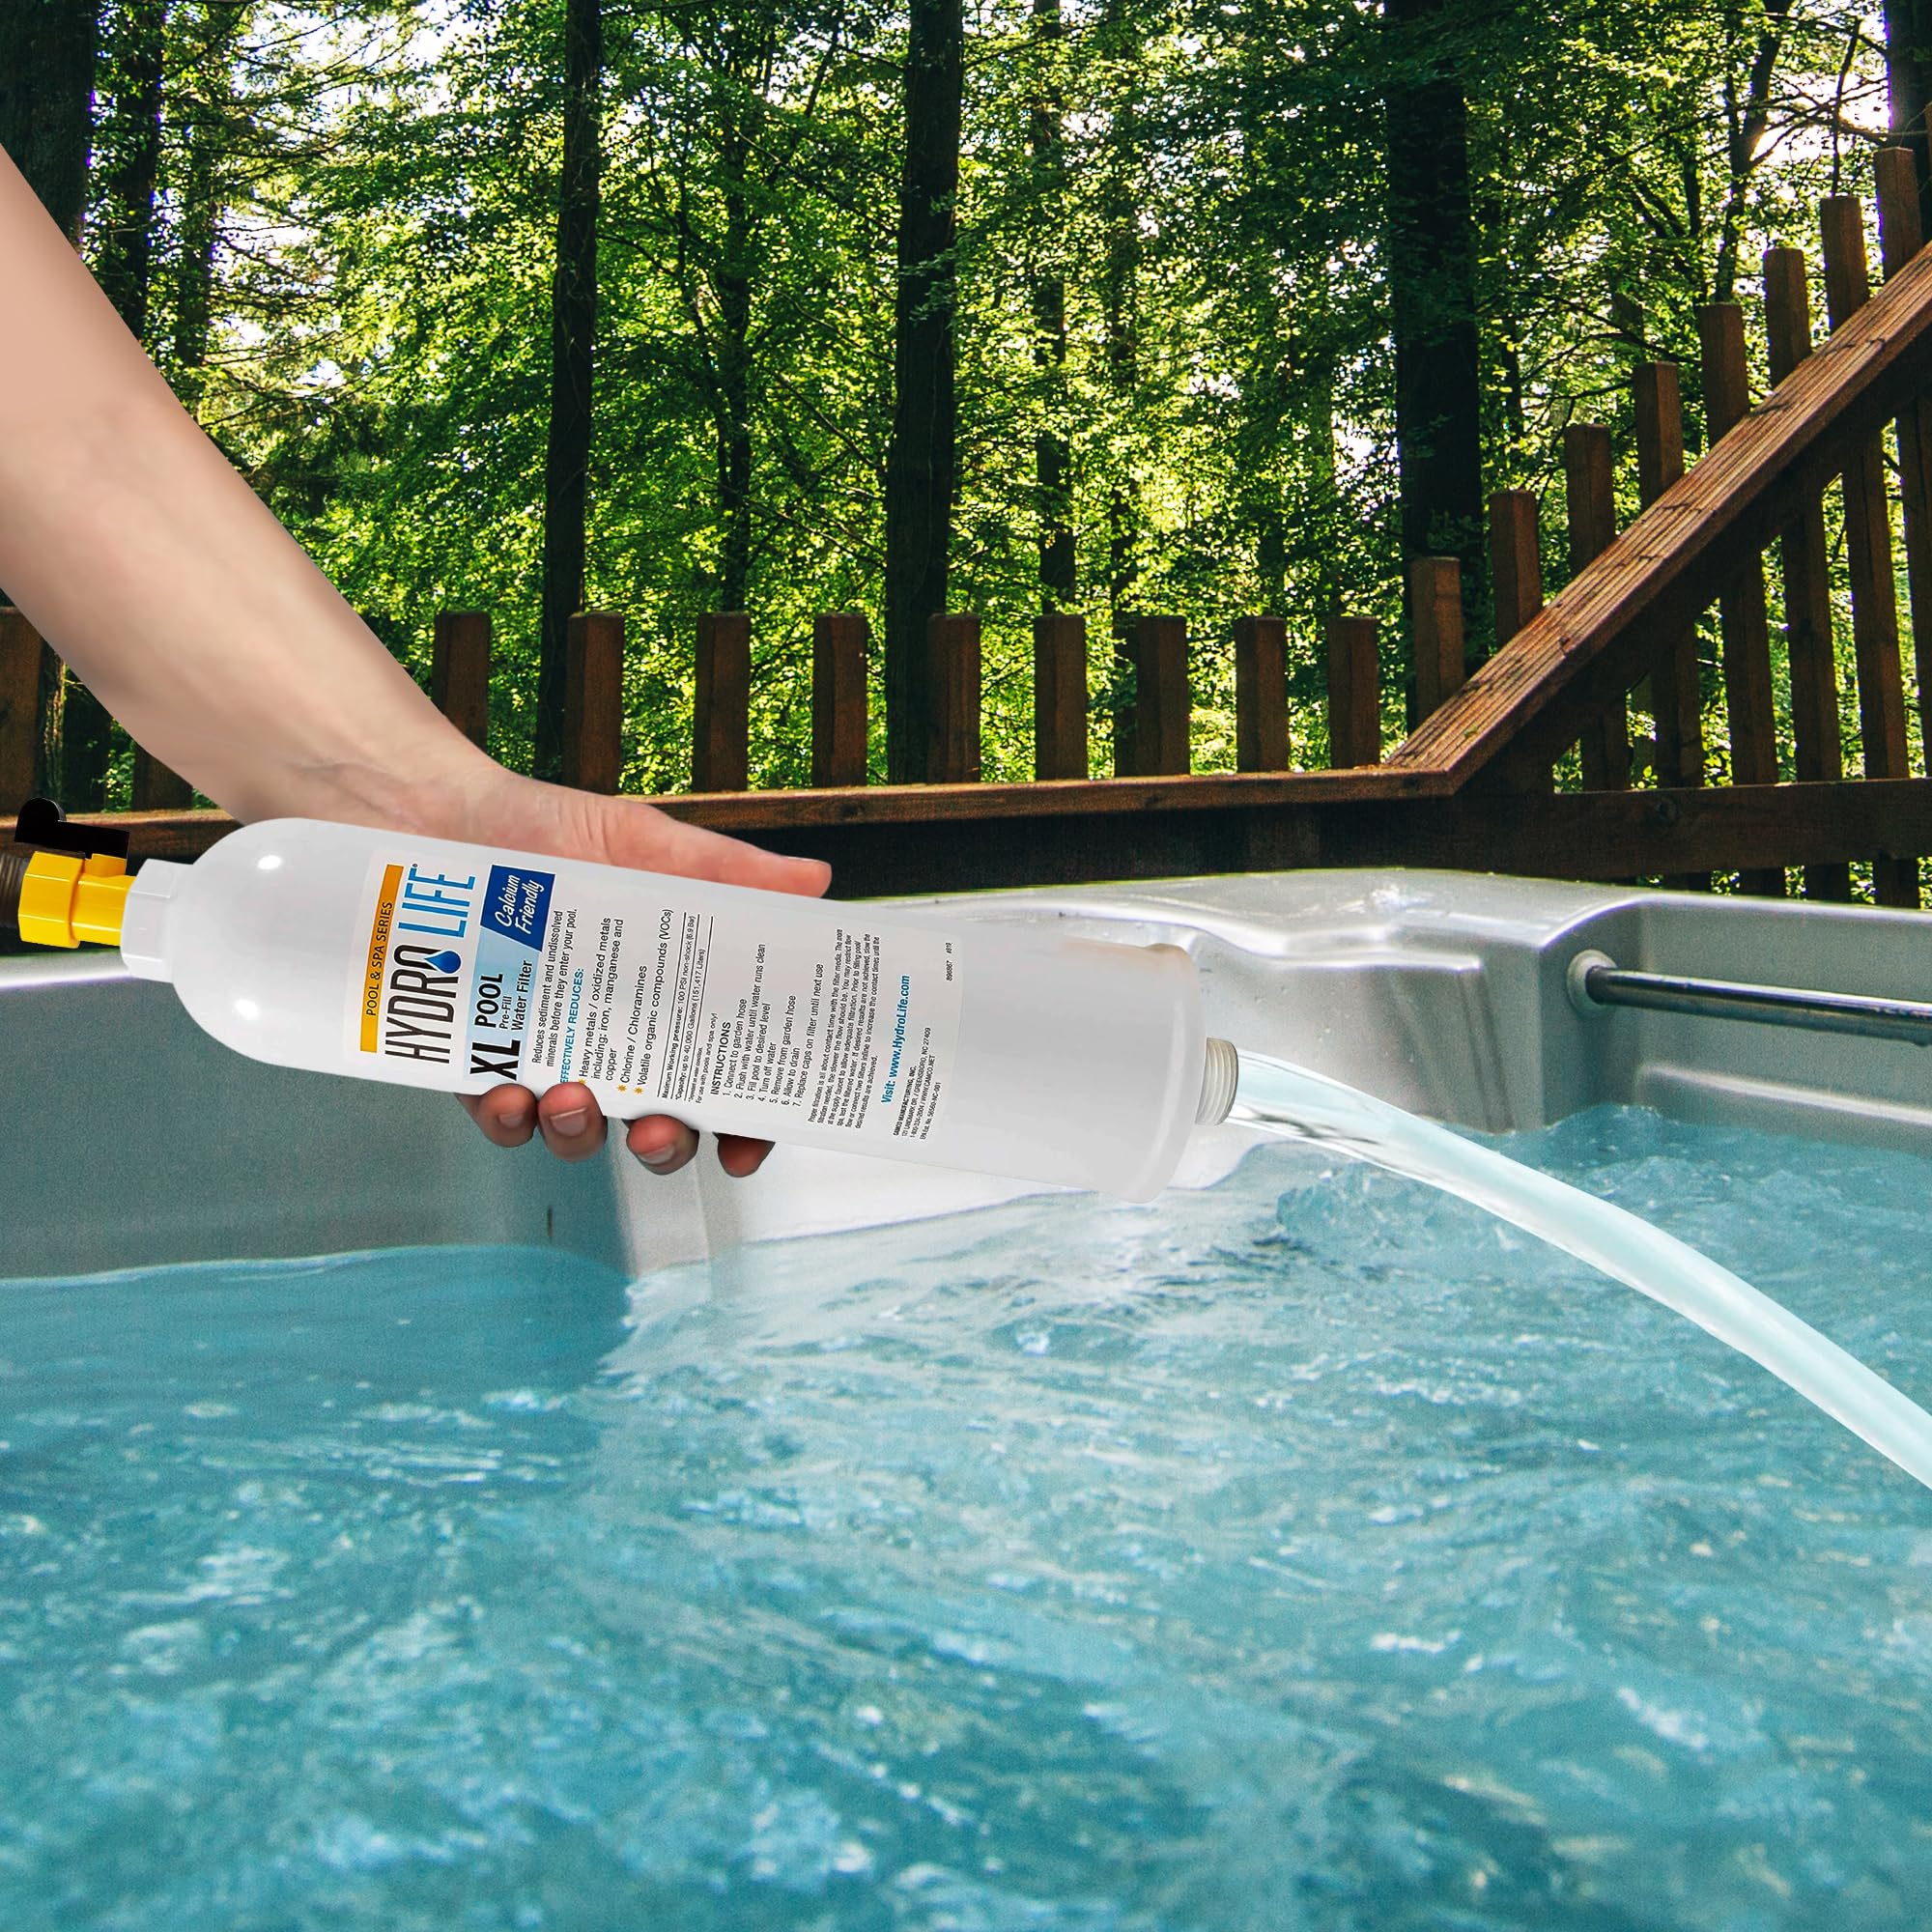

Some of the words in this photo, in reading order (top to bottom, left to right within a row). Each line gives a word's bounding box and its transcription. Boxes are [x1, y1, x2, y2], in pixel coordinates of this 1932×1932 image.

[495, 875, 520, 926] Calcium
[515, 880, 545, 934] Friendly
[376, 902, 392, 942] SERIES
[567, 909, 577, 928] pool.
[614, 919, 624, 938] and
[659, 909, 674, 940] (VOCs)
[548, 911, 563, 962] undissolved
[563, 929, 574, 951] your
[600, 918, 611, 952] metals
[372, 946, 384, 968] SPA
[559, 952, 570, 976] enter
[696, 949, 706, 969] Liters)
[755, 944, 765, 964] clean
[517, 960, 532, 993] Filter
[545, 964, 554, 982] and
[591, 953, 605, 1001] oxidized
[605, 941, 620, 1004] manganese
[652, 943, 668, 1008] compounds
[841, 979, 850, 990] You
[366, 984, 380, 1016] POOL
[474, 974, 503, 1028] POOL
[554, 979, 568, 999] they
[568, 969, 583, 1024] REDUCES:
[752, 984, 760, 1008] water
[813, 980, 822, 997] next
[385, 945, 462, 1064] HYDRO
[499, 996, 512, 1030] Pre-Fill
[511, 996, 526, 1030] Water
[538, 984, 552, 1028] sediment
[550, 1002, 562, 1031] before
[688, 1003, 697, 1030] Gallons
[736, 999, 747, 1018] hose
[759, 1003, 771, 1022] level
[785, 996, 796, 1015] hose
[810, 998, 819, 1016] until
[838, 1003, 847, 1025] should
[847, 994, 858, 1021] filtration.
[585, 1011, 597, 1047] metals
[598, 1008, 612, 1031] iron,
[620, 1045, 636, 1083] Chlorine
[628, 966, 647, 1036] Chloramines
[645, 1010, 658, 1051] organic
[662, 1072, 672, 1098] Maximum
[667, 1043, 679, 1070] Working
[673, 1007, 683, 1041] pressure:
[683, 941, 692, 976] non-shock
[749, 1009, 757, 1028] until
[782, 1017, 793, 1045] garden
[807, 1017, 817, 1037] filter
[828, 1013, 837, 1028] time
[866, 1009, 875, 1035] increase
[531, 1030, 545, 1064] Reduces
[684, 1031, 694, 1054] 40,000
[733, 1021, 743, 1049] garden
[745, 1029, 754, 1052] water
[755, 1024, 767, 1054] desired
[806, 1038, 813, 1049] on
[825, 1029, 834, 1053] contact
[853, 1028, 863, 1051] desired
[881, 1081, 895, 1102] Visit:
[889, 976, 910, 1077] www.HydroLife.com
[469, 1039, 521, 1081] XL
[546, 1033, 558, 1066] minerals
[591, 1034, 609, 1079] including:
[711, 1022, 731, 1094] INSTRUCTIONS
[741, 1054, 751, 1069] with
[767, 1042, 777, 1065] water
[777, 1047, 788, 1065] from
[802, 1051, 812, 1069] caps
[821, 1054, 830, 1071] about
[830, 1052, 839, 1072] slower
[861, 1044, 870, 1061] inline
[579, 1049, 593, 1077] Heavy
[606, 1048, 617, 1081] copper
[638, 1053, 651, 1085] Volatile
[724, 1060, 737, 1088] Connect
[752, 1065, 760, 1081] pool
[763, 1065, 772, 1076] off
[783, 1078, 794, 1097] Allow
[789, 1047, 800, 1067] drain
[849, 1059, 858, 1077] water.
[858, 1063, 867, 1079] filters
[867, 1056, 878, 1084] achieved.
[736, 1071, 747, 1090] Flush
[748, 1082, 757, 1092] Fill
[759, 1077, 770, 1093] Turn
[771, 1067, 784, 1095] Remove
[794, 1070, 808, 1098] Replace
